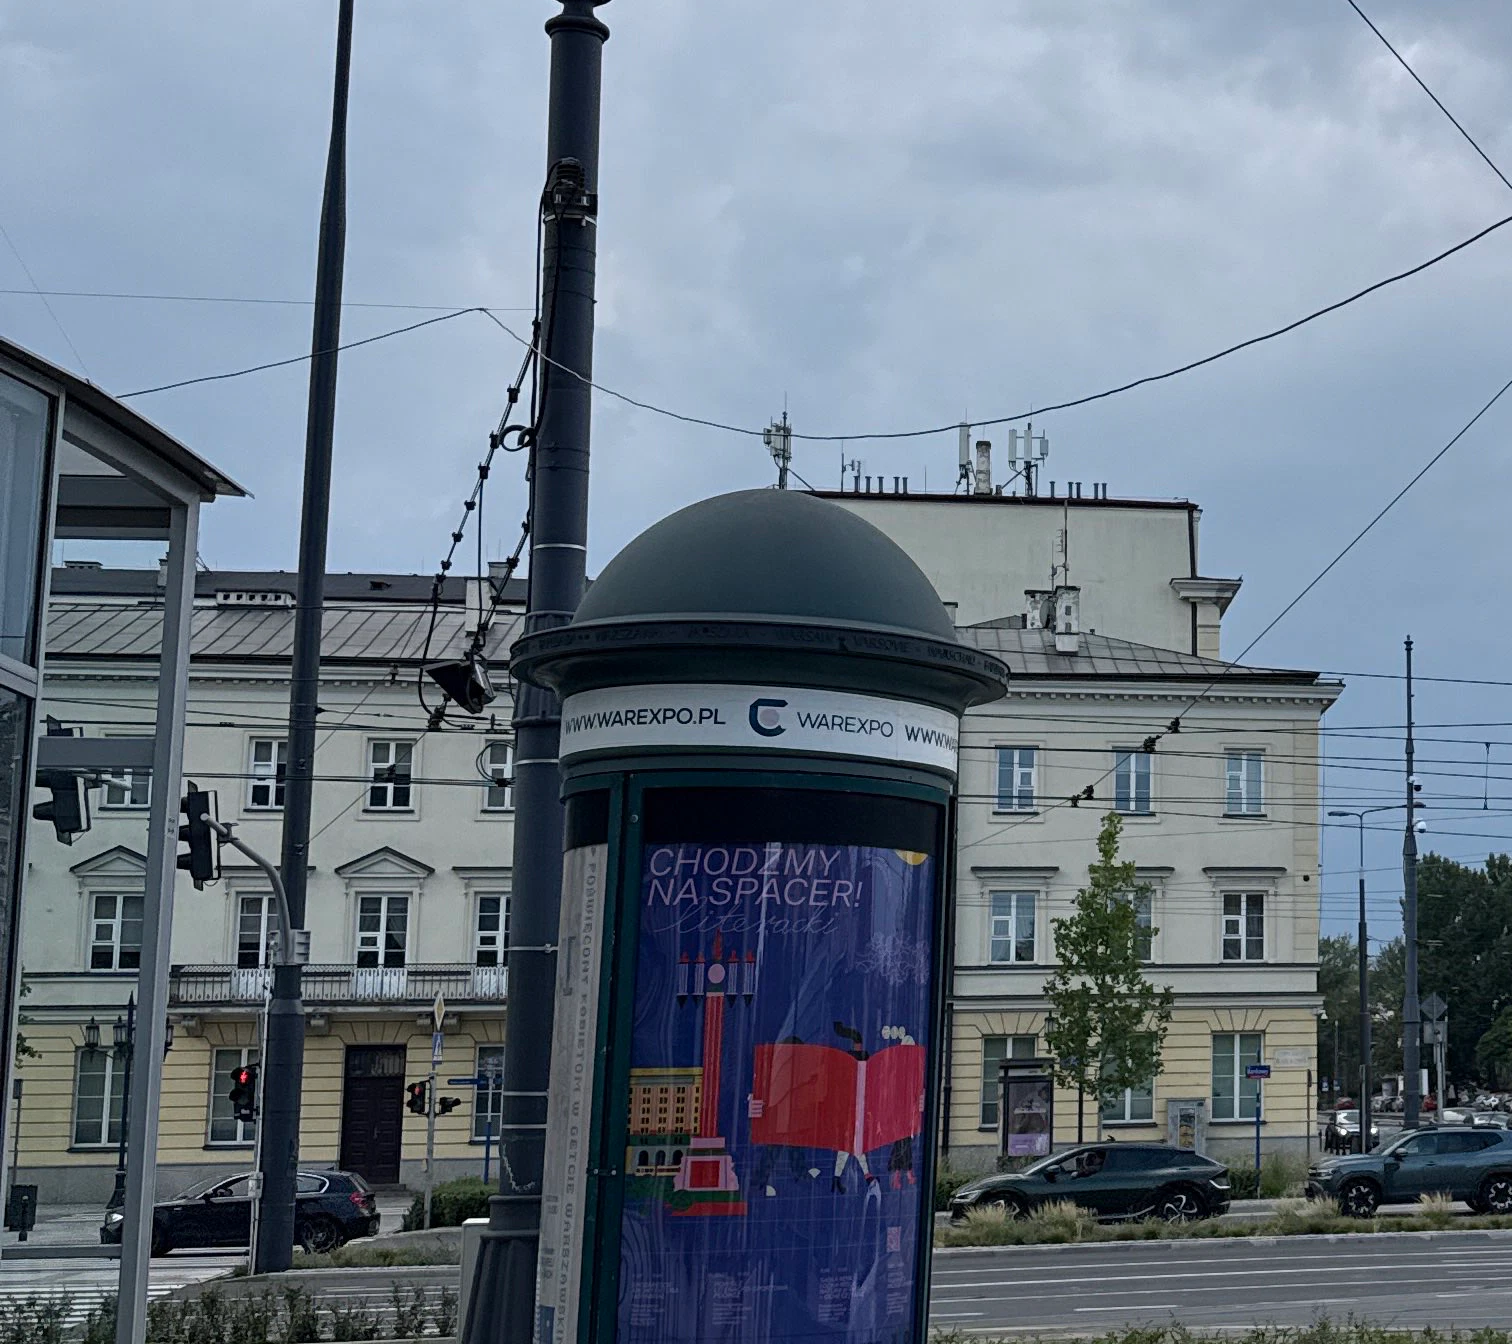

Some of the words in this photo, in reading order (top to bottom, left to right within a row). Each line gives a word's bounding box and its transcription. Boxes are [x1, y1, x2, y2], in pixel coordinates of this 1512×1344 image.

[565, 707, 726, 735] WWW.WAREXPO.PL
[797, 711, 894, 738] WAREXPO
[647, 877, 699, 906] NA
[709, 877, 863, 908] SPACER!
[653, 896, 840, 935] literacki
[573, 993, 588, 1093] KOBIETOM
[571, 1101, 580, 1117] W
[566, 1125, 579, 1195] GETCIE
